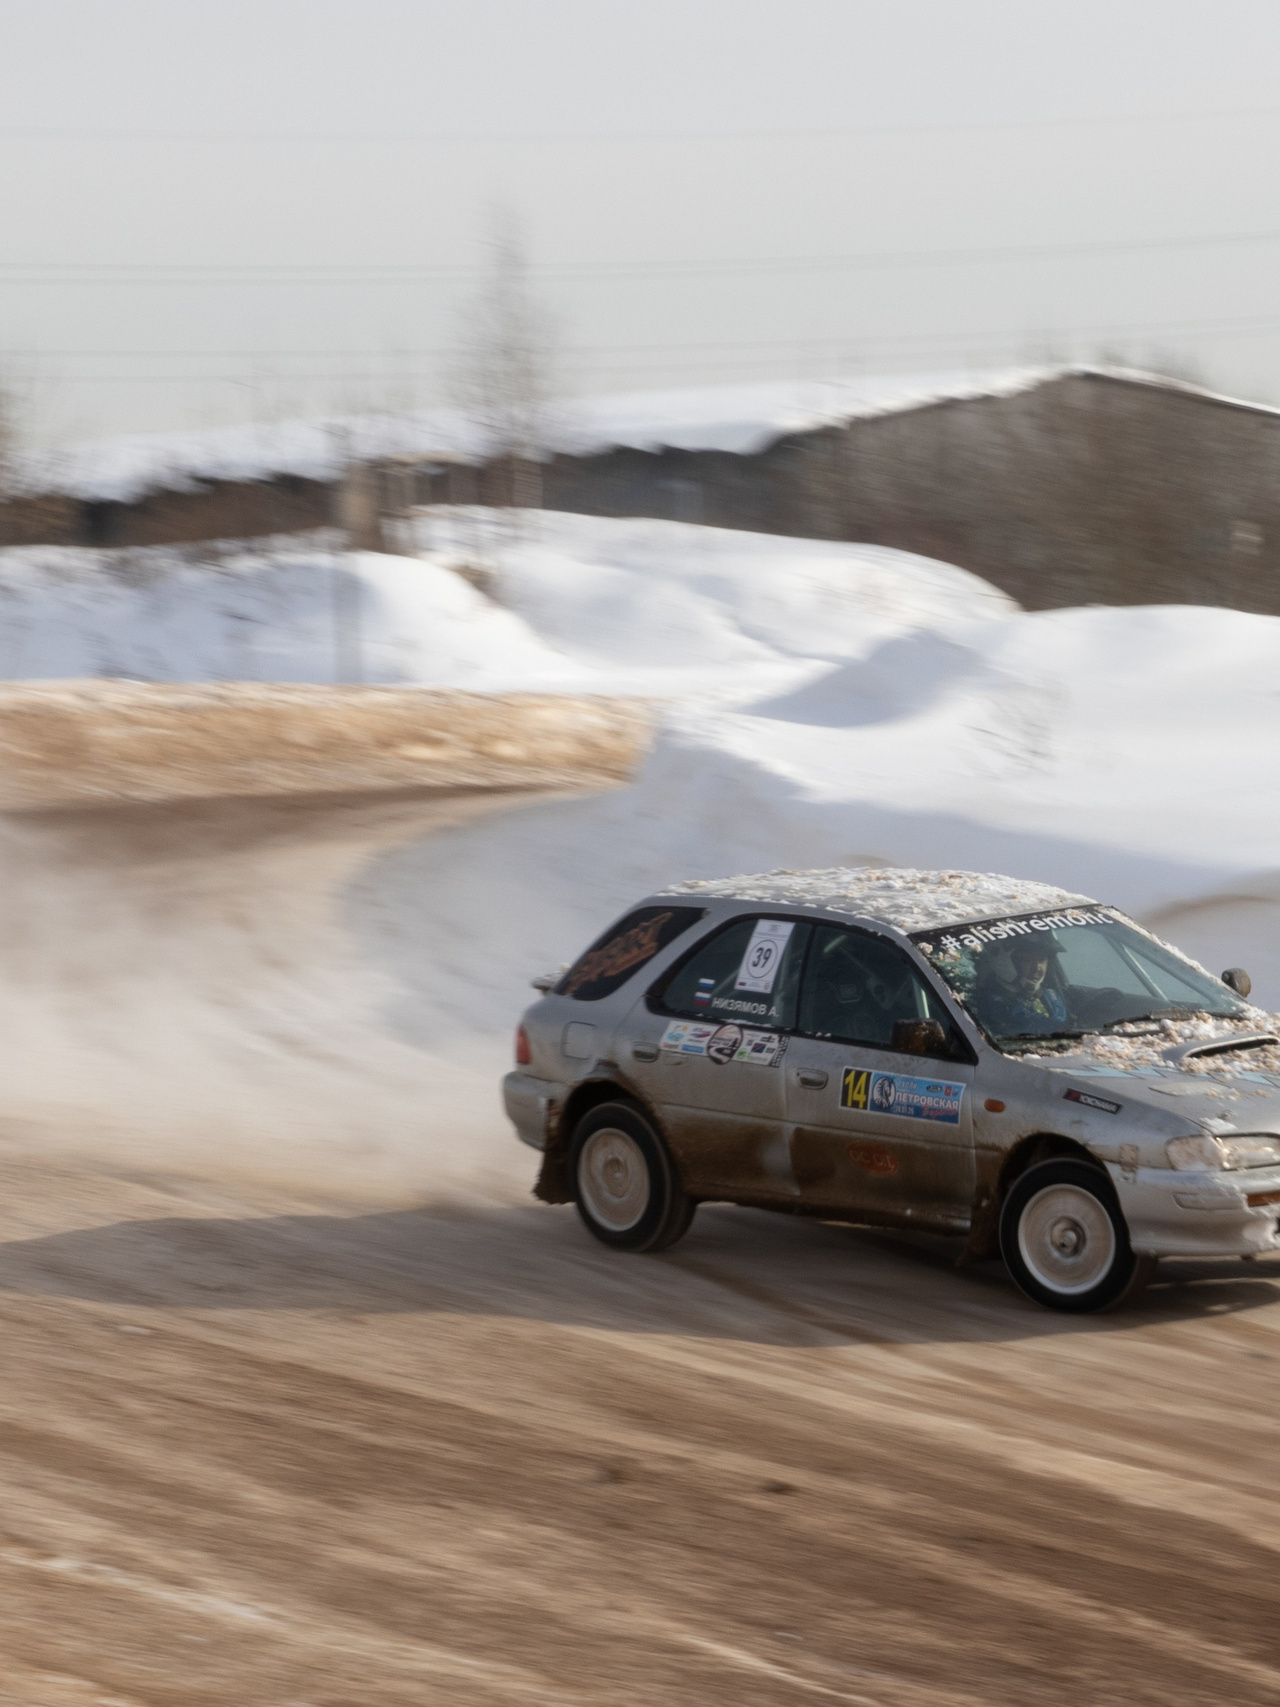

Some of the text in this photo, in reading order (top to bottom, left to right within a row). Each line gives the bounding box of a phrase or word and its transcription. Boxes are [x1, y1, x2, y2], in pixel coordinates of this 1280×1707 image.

[752, 947, 772, 969] 39
[711, 997, 779, 1018] НИЗЯМОВ А.
[845, 1070, 867, 1109] 14
[895, 1091, 959, 1110] ПЕТРОВСКАЯ
